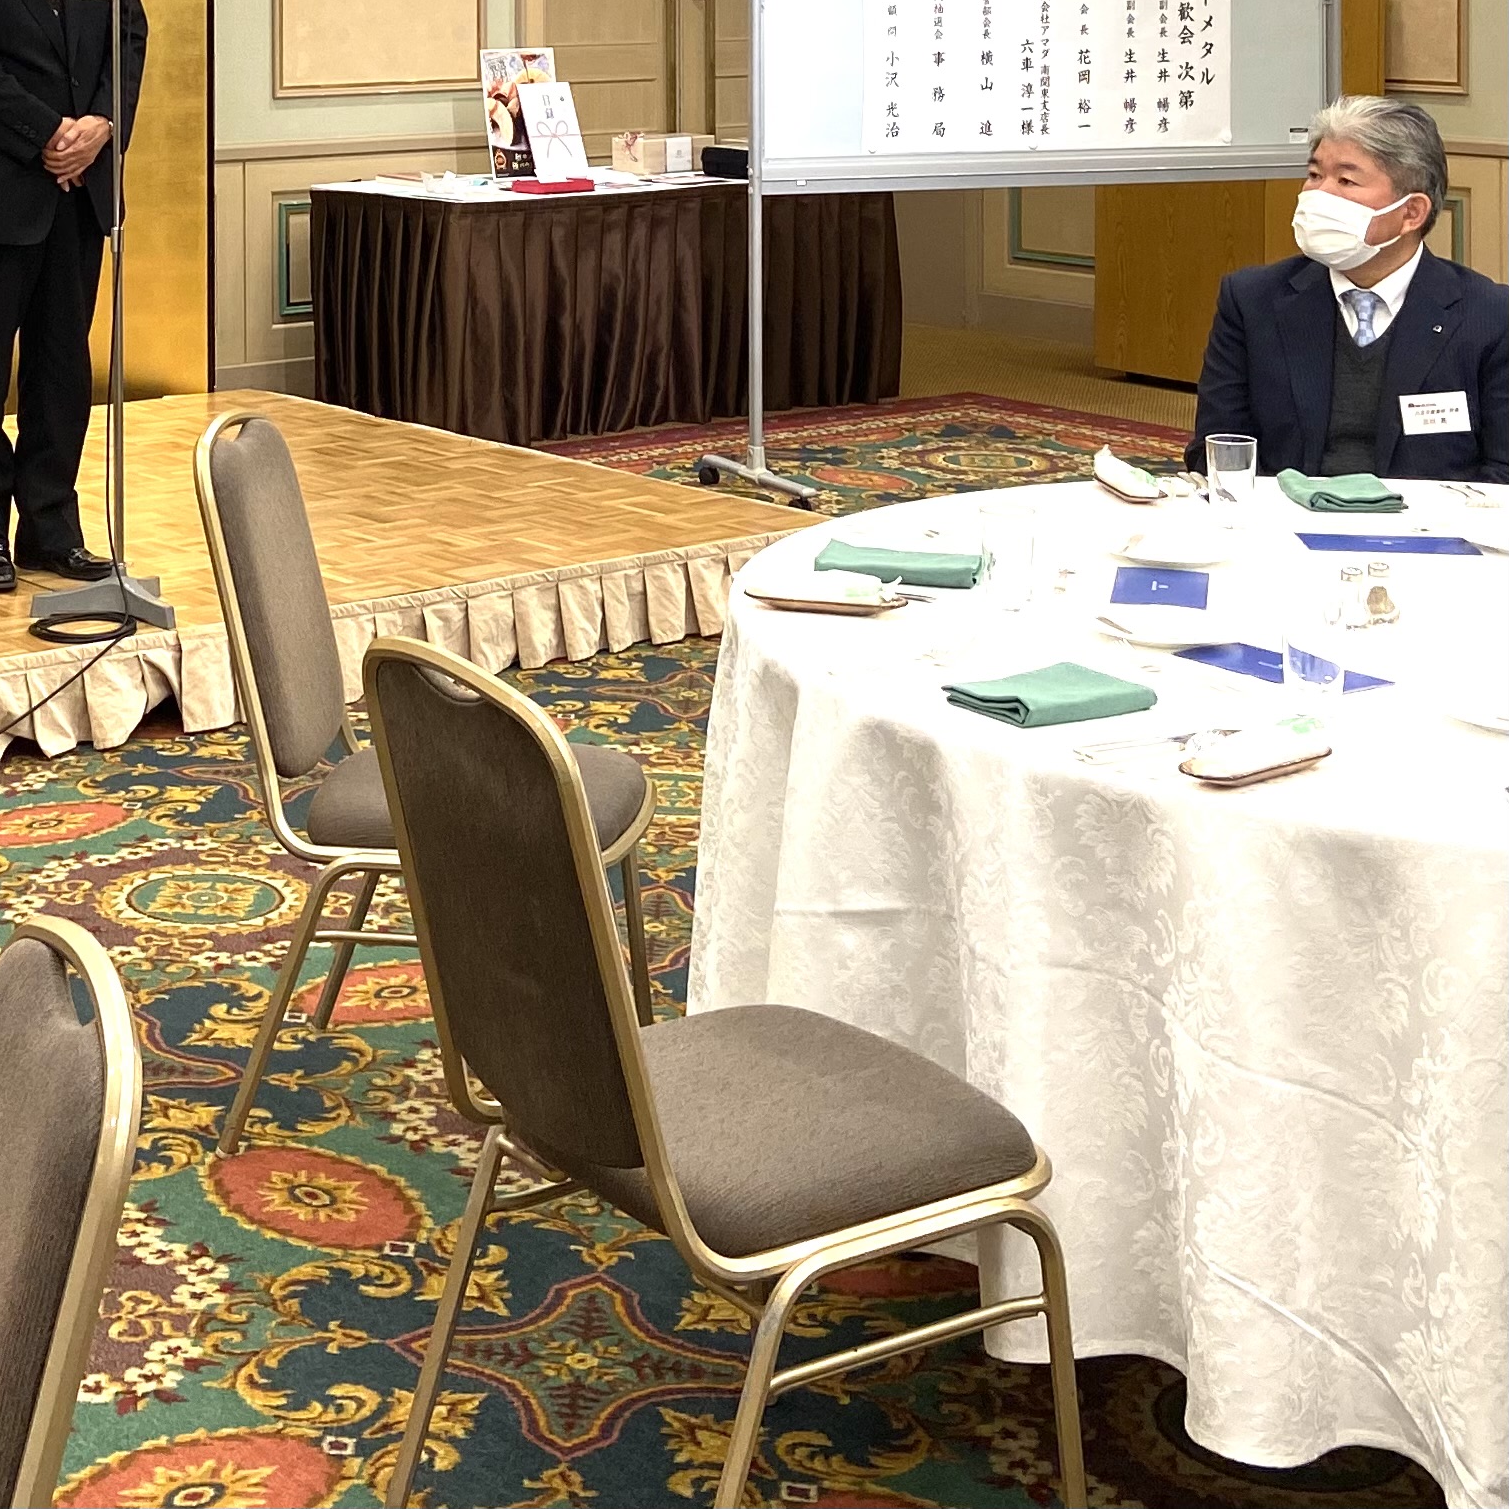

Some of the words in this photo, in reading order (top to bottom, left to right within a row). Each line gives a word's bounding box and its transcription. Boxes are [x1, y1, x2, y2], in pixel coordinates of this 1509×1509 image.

[1079, 3, 1090, 36] 会長
[931, 50, 946, 138] 事務局
[1039, 63, 1051, 136] 南関東支店長
[1177, 61, 1196, 111] 次第
